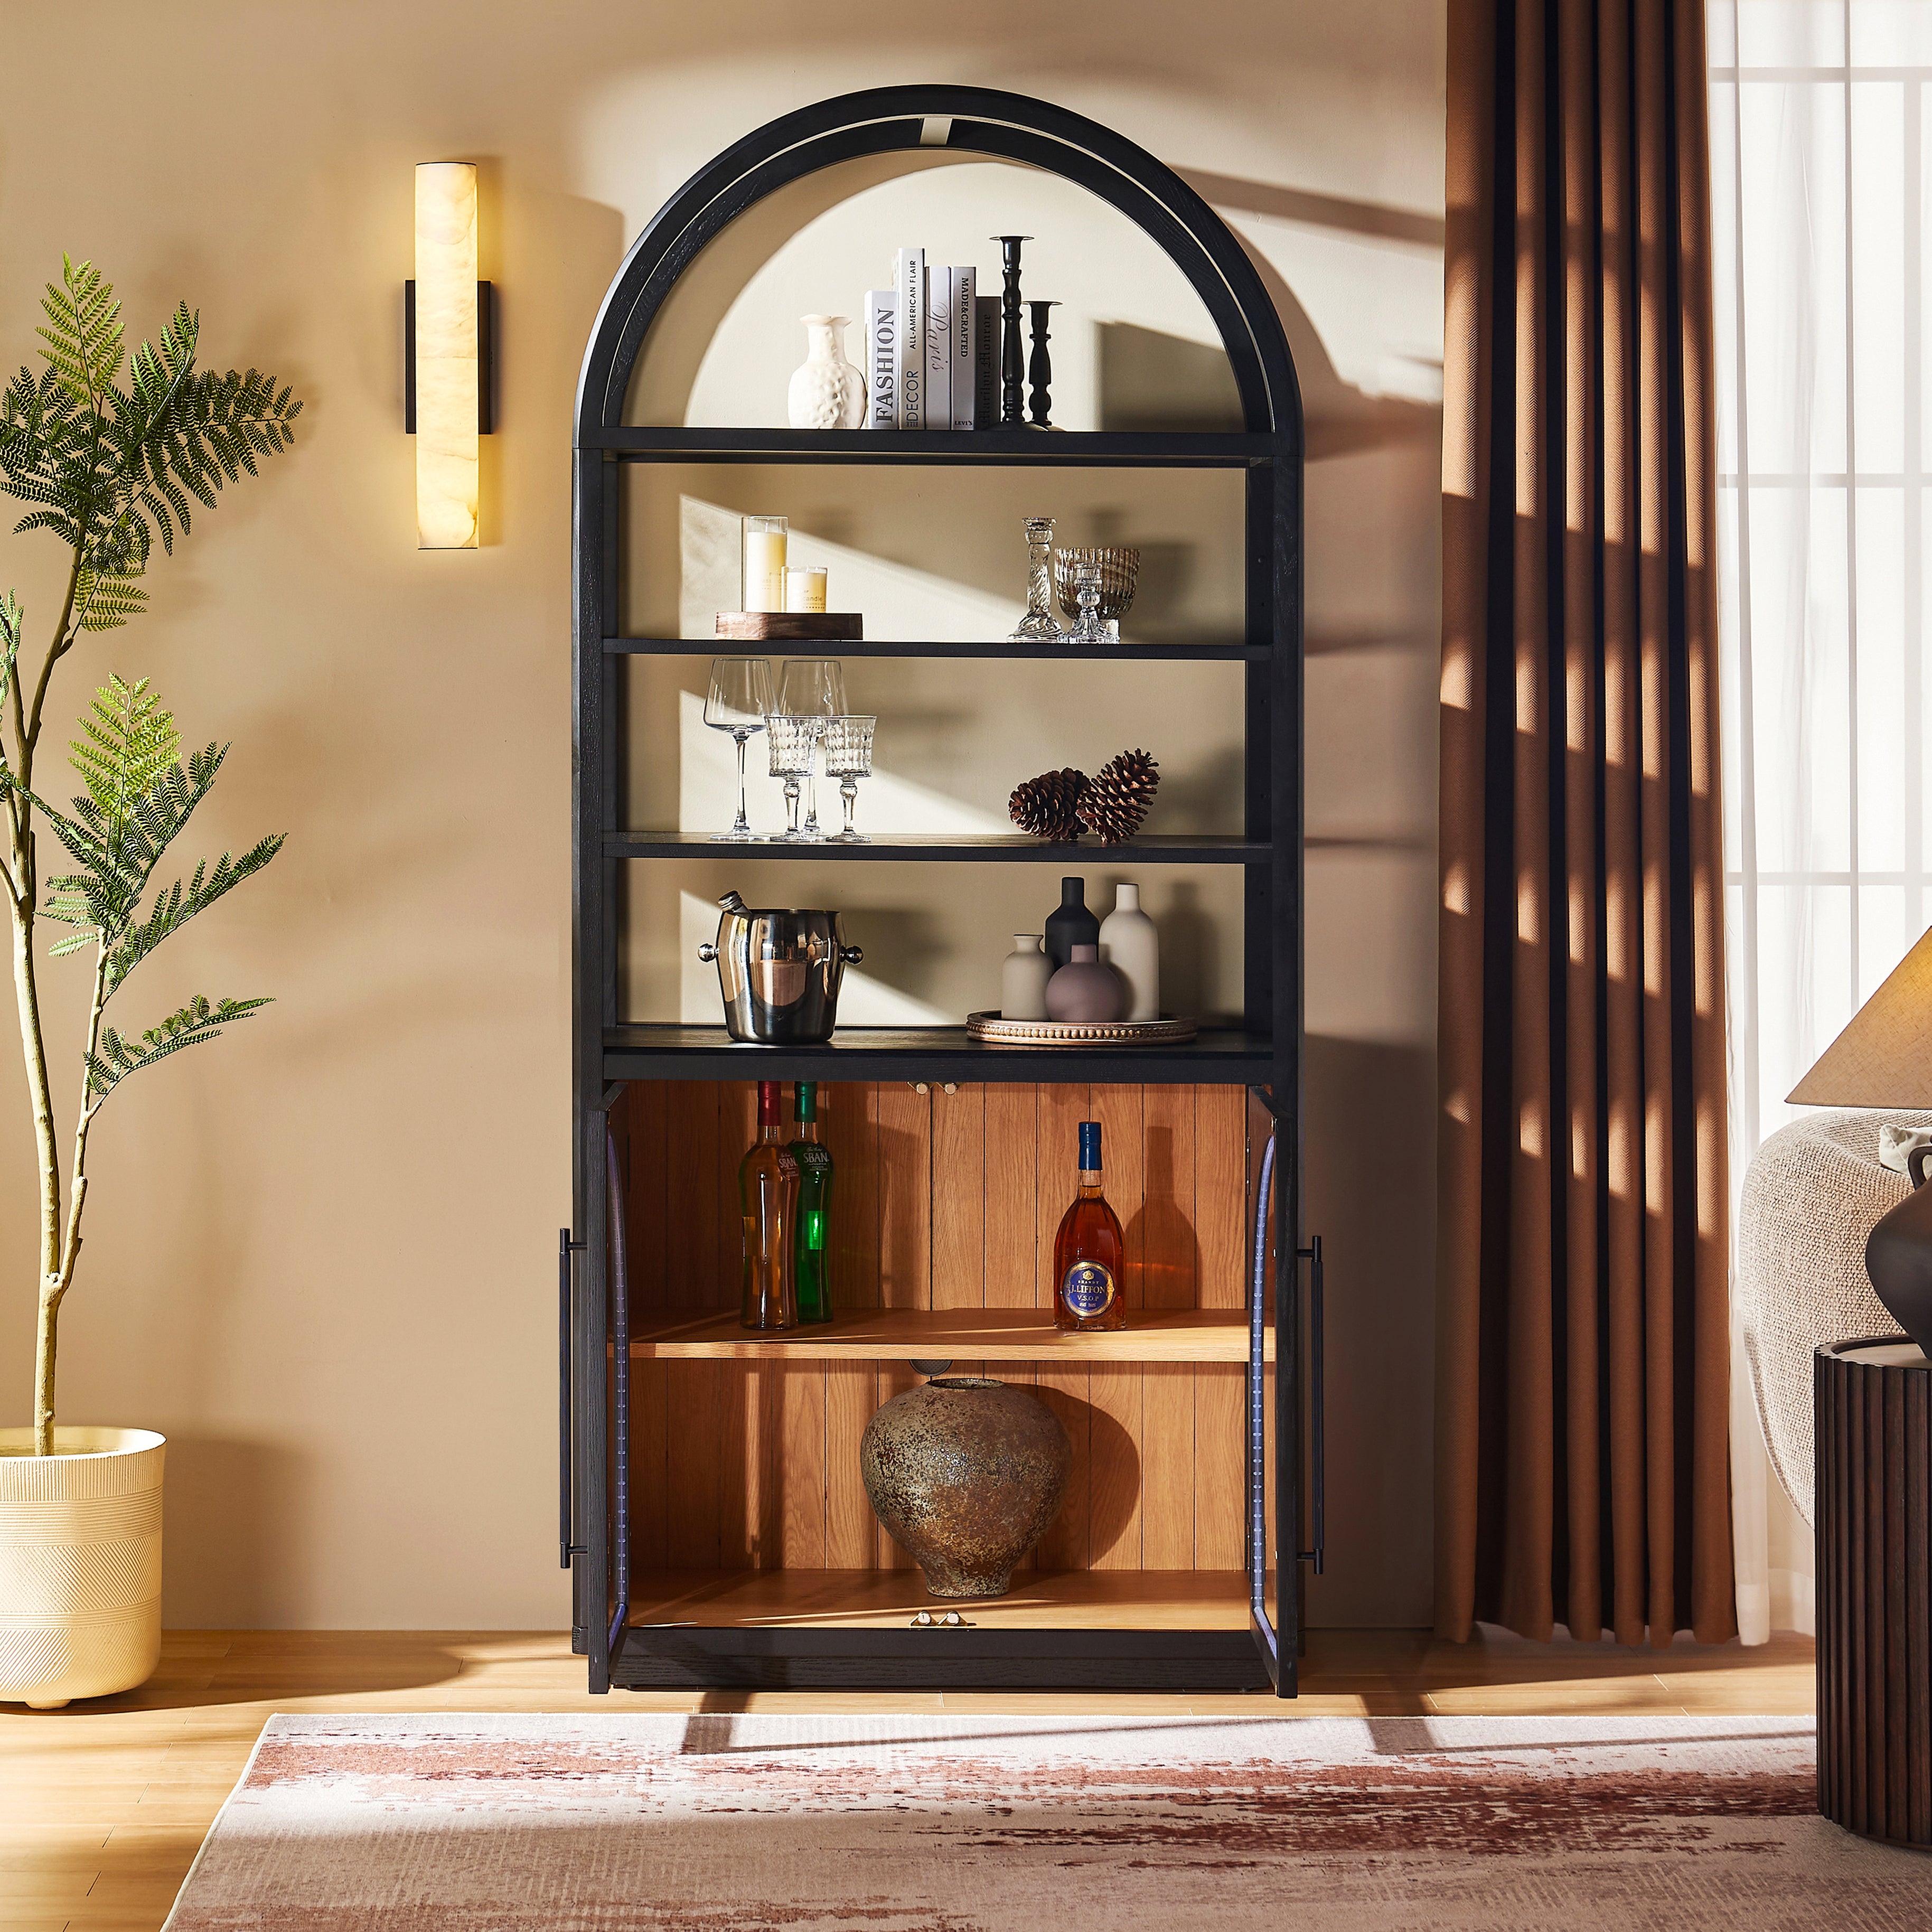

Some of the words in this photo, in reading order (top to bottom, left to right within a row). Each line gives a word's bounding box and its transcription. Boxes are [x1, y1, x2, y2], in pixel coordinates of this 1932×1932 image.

[876, 308, 894, 422] FASHION
[926, 302, 949, 372] Paris
[979, 314, 995, 370] Monroe
[906, 371, 918, 421] DECOR
